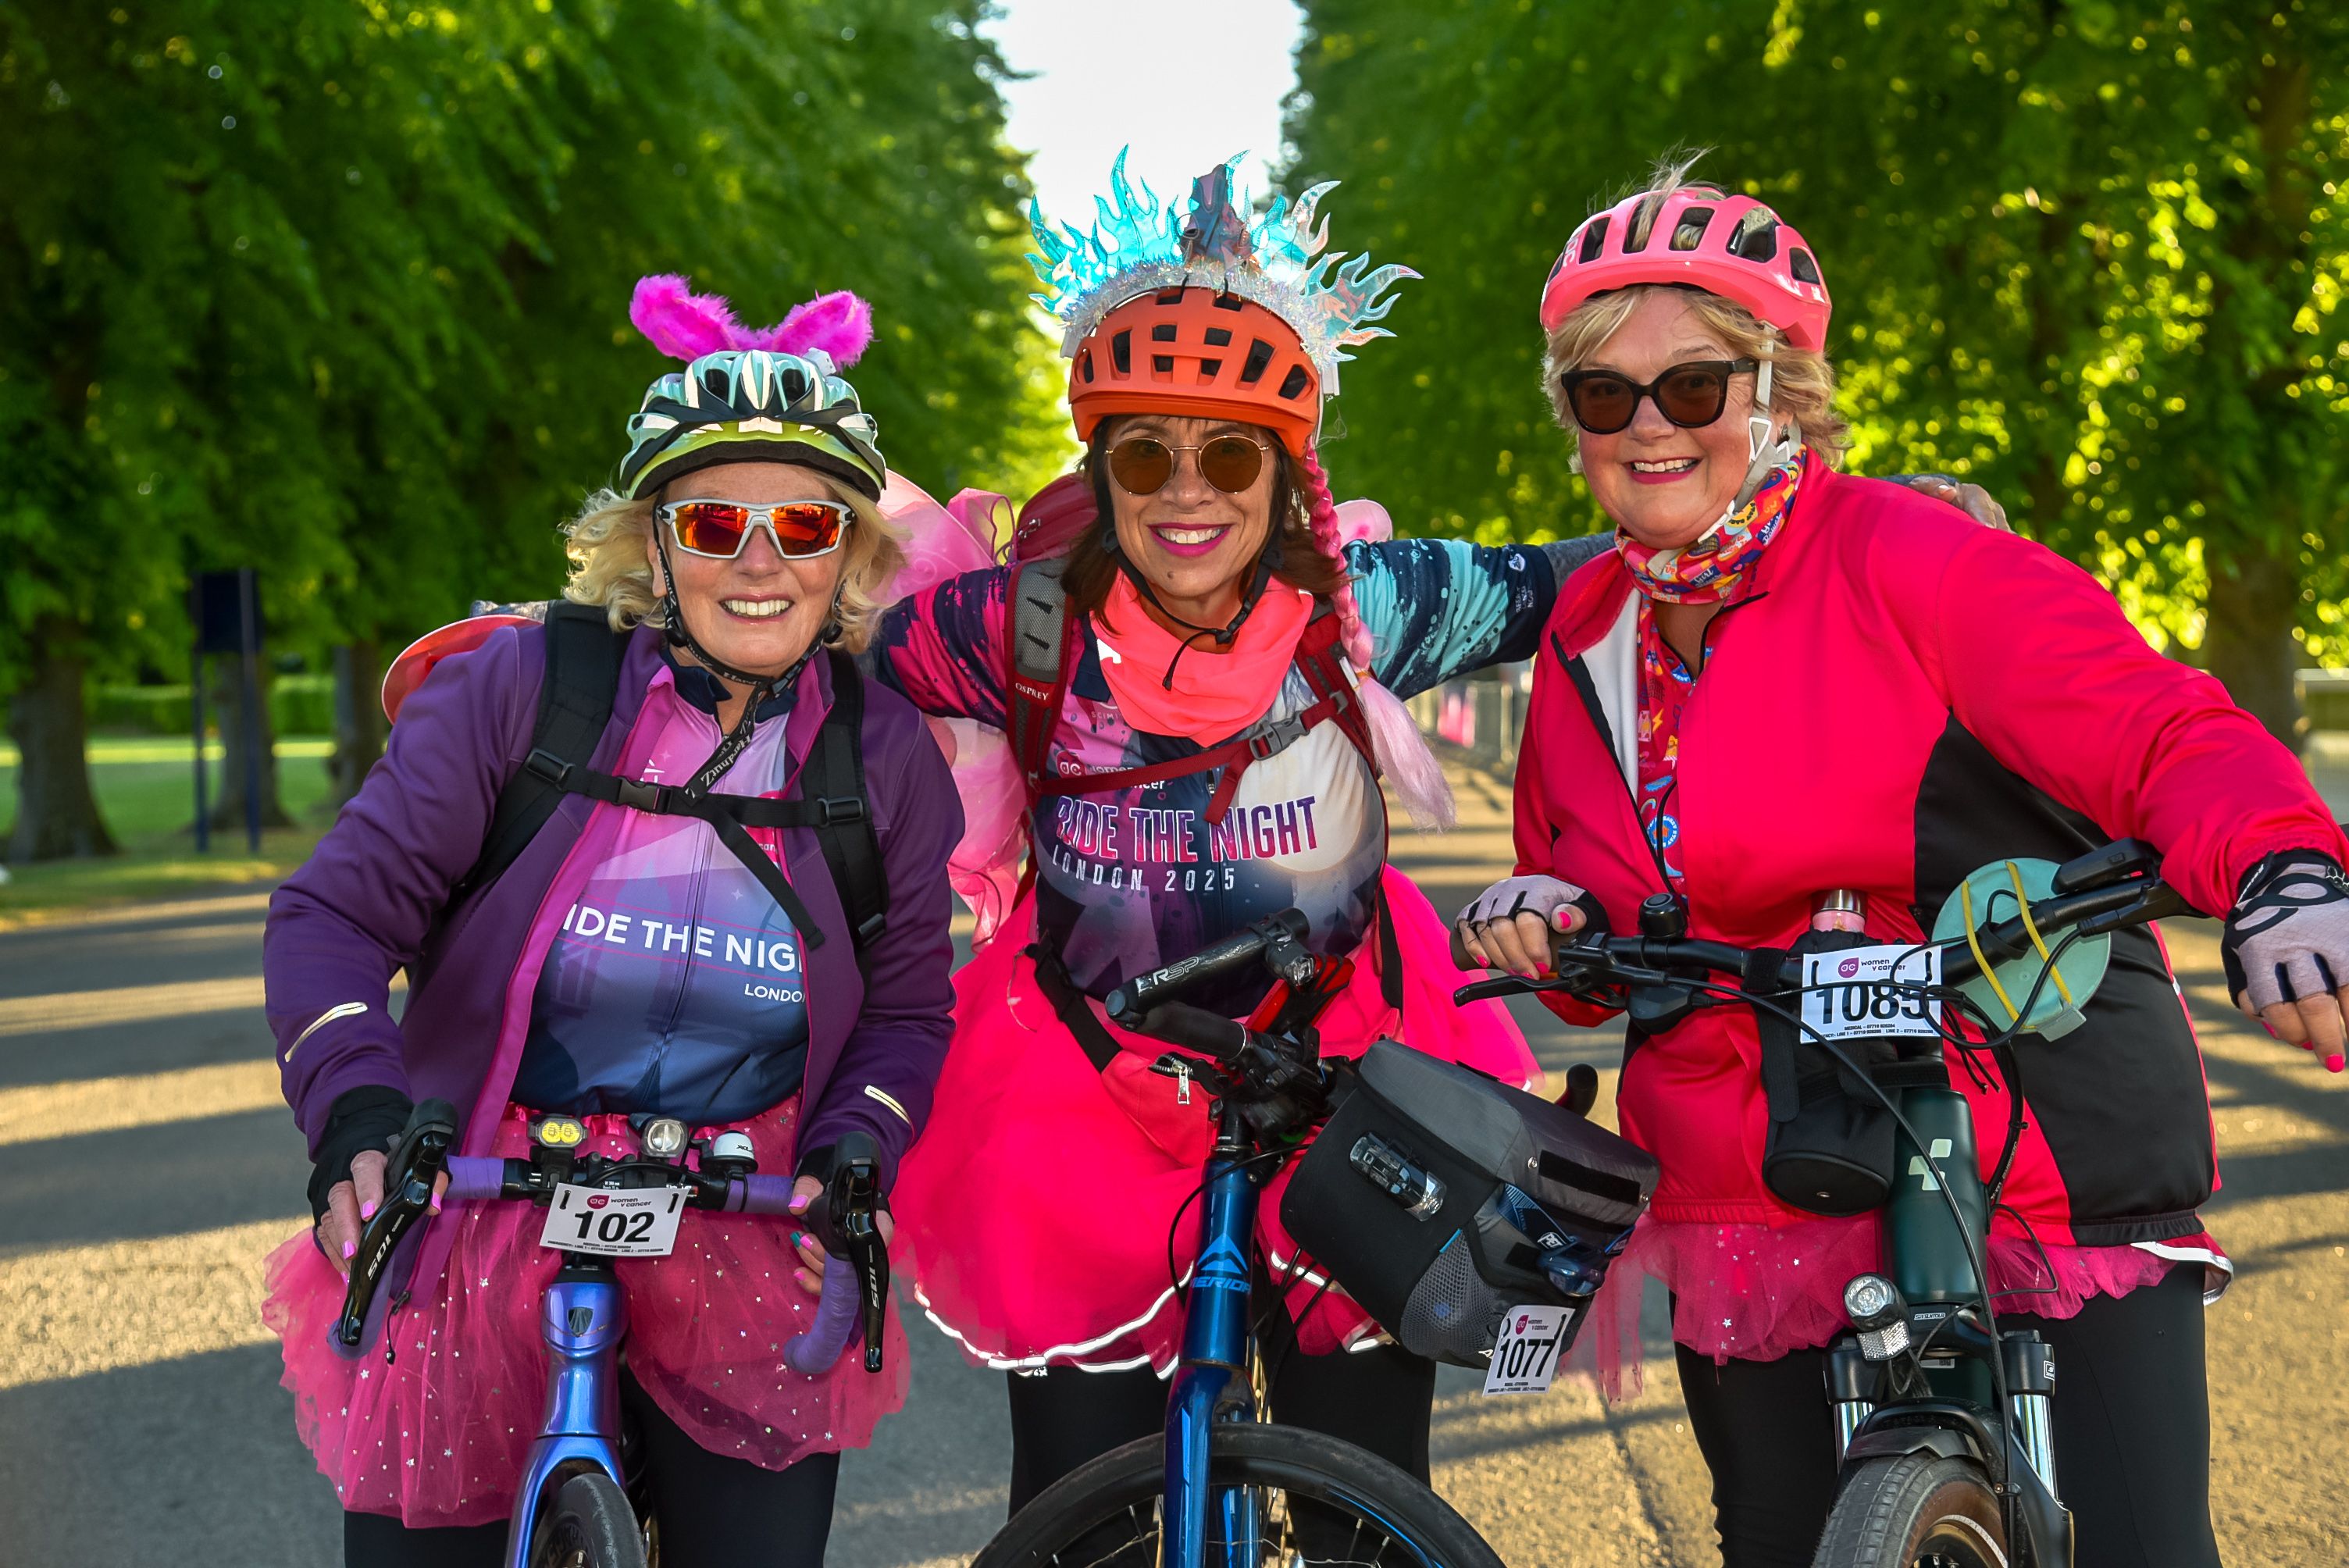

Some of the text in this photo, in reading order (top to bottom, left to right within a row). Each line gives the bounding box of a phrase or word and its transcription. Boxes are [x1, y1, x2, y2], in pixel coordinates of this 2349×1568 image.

[1015, 682, 1049, 700] OSPREY
[1056, 795, 1317, 863] RIDE THE NIGHT
[1052, 845, 1235, 892] LONDON 2025
[562, 903, 804, 973] IDE THE NIG
[1153, 956, 1199, 985] RSP
[1816, 978, 1930, 1025] 1085
[575, 1210, 655, 1242] 102
[1496, 1338, 1556, 1379] 1077
